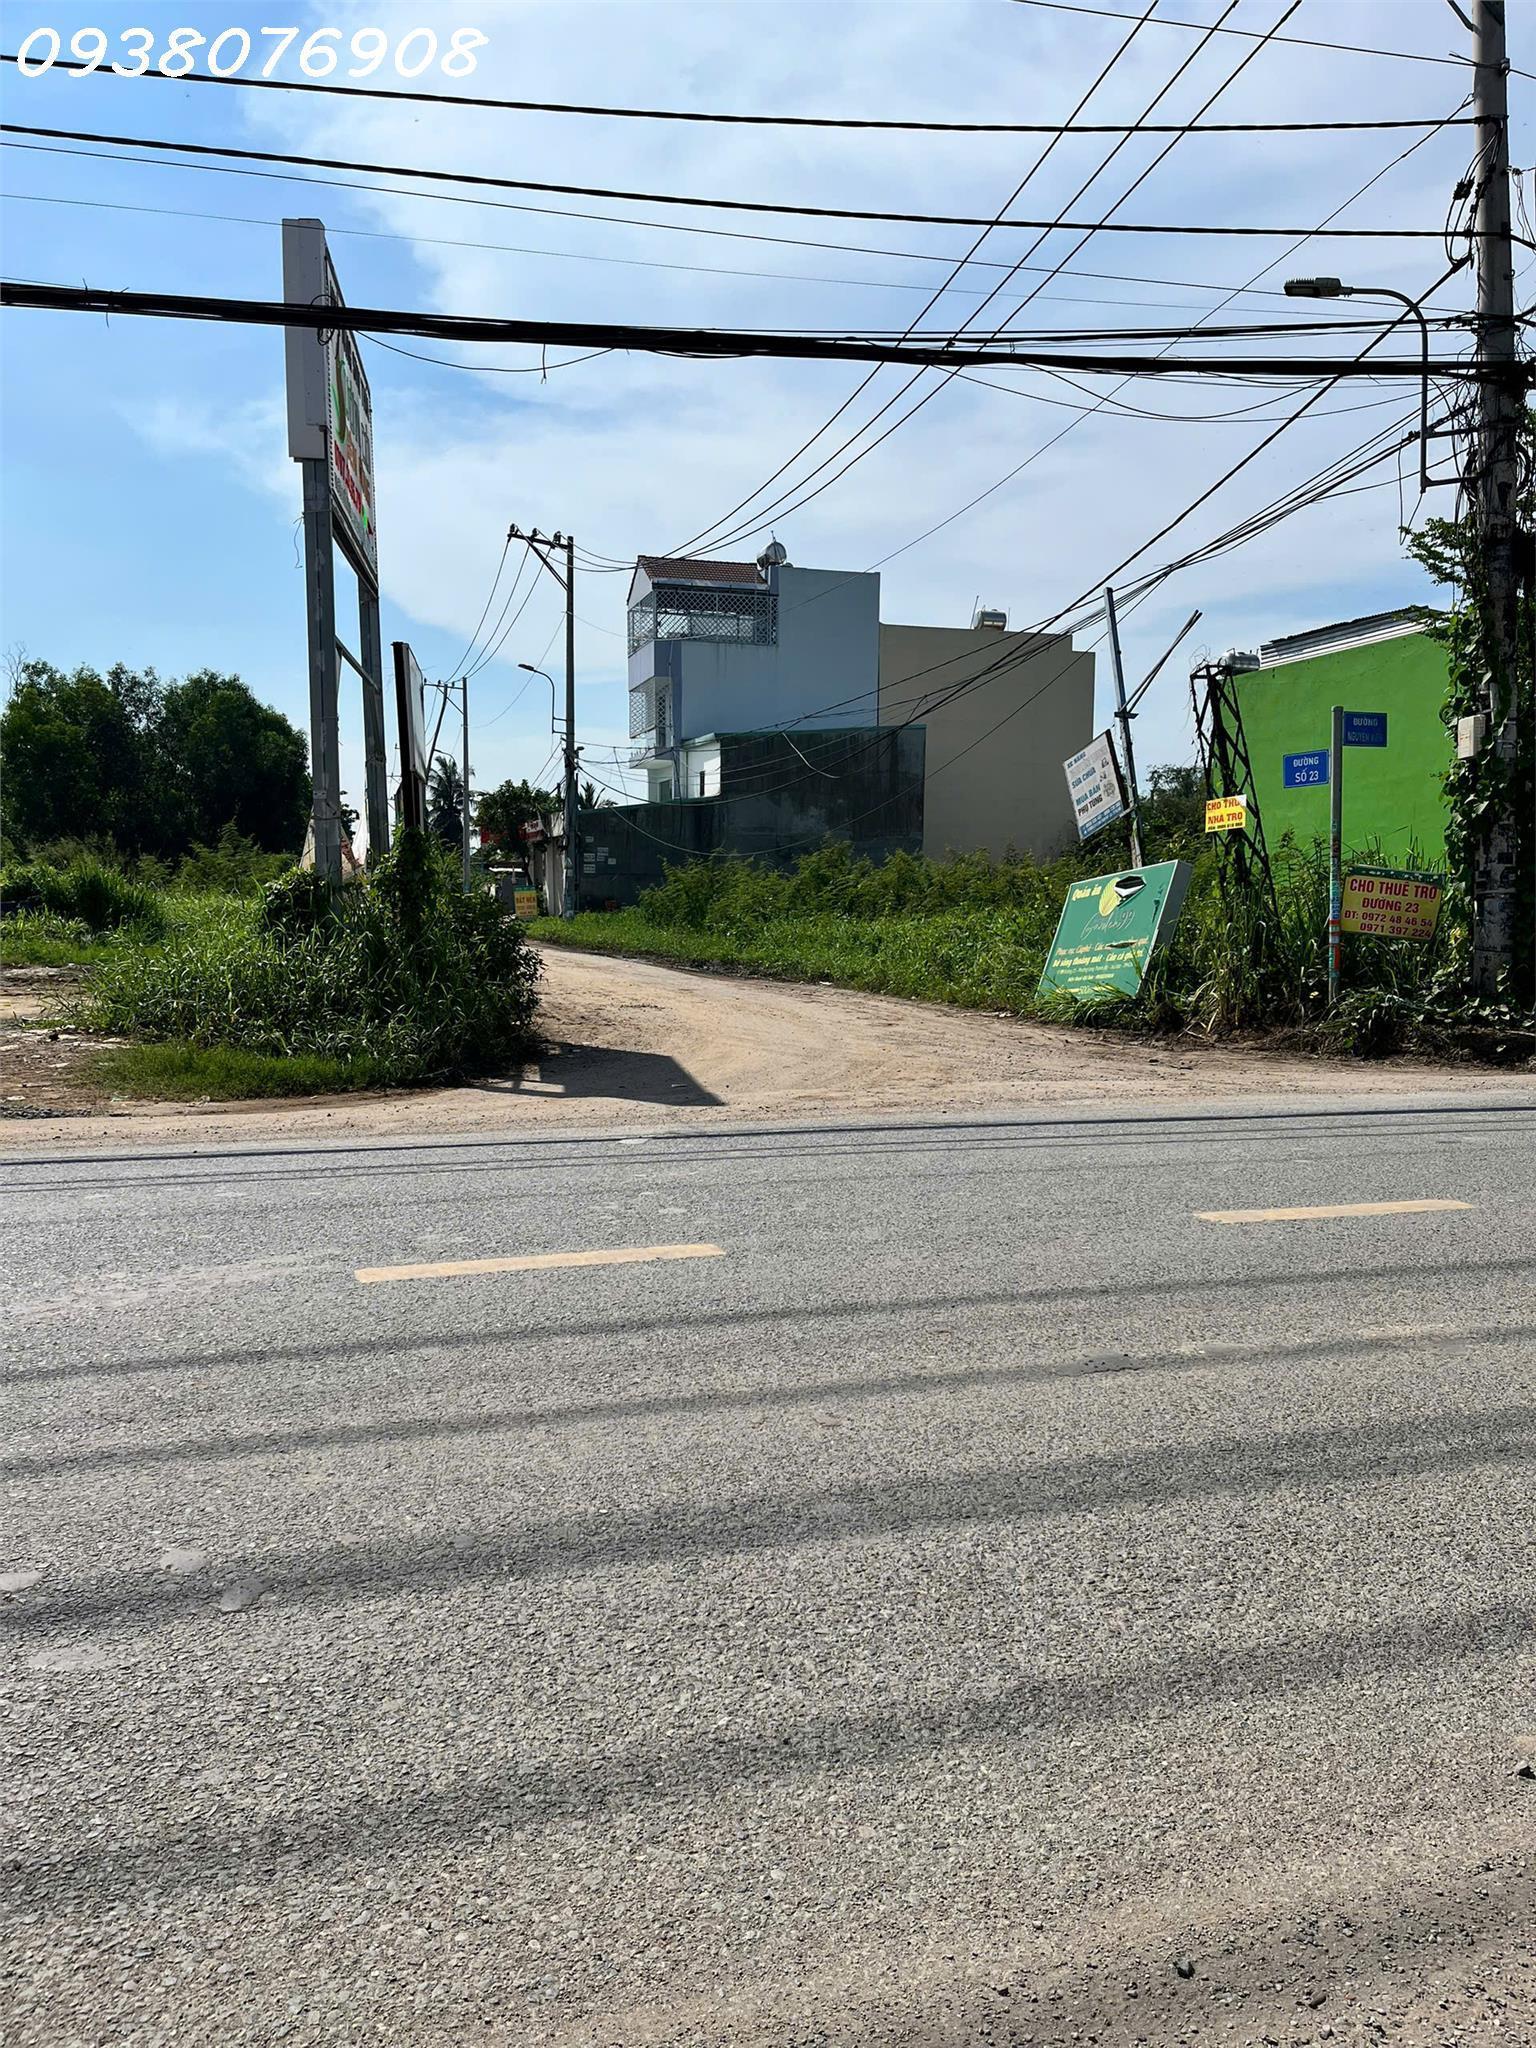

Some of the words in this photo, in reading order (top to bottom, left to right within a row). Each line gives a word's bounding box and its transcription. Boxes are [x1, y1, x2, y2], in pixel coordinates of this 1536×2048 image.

[1293, 756, 1319, 768] ĐƯỜNG
[1295, 767, 1307, 783] SỐ
[1309, 770, 1319, 781] 23
[1208, 801, 1221, 810] CHO
[1223, 798, 1241, 808] THU
[1350, 879, 1375, 893] CHO
[1379, 881, 1409, 897] THUÊ
[1414, 885, 1438, 902] TRỌ
[1362, 896, 1402, 912] ĐƯỜNG
[1404, 902, 1420, 914] 23
[1344, 910, 1359, 919] ĐT:
[1361, 912, 1386, 923] 0972
[1389, 914, 1402, 924] 48
[1360, 923, 1385, 933] 0971
[1388, 925, 1409, 936] 397
[1411, 928, 1432, 938] 224
